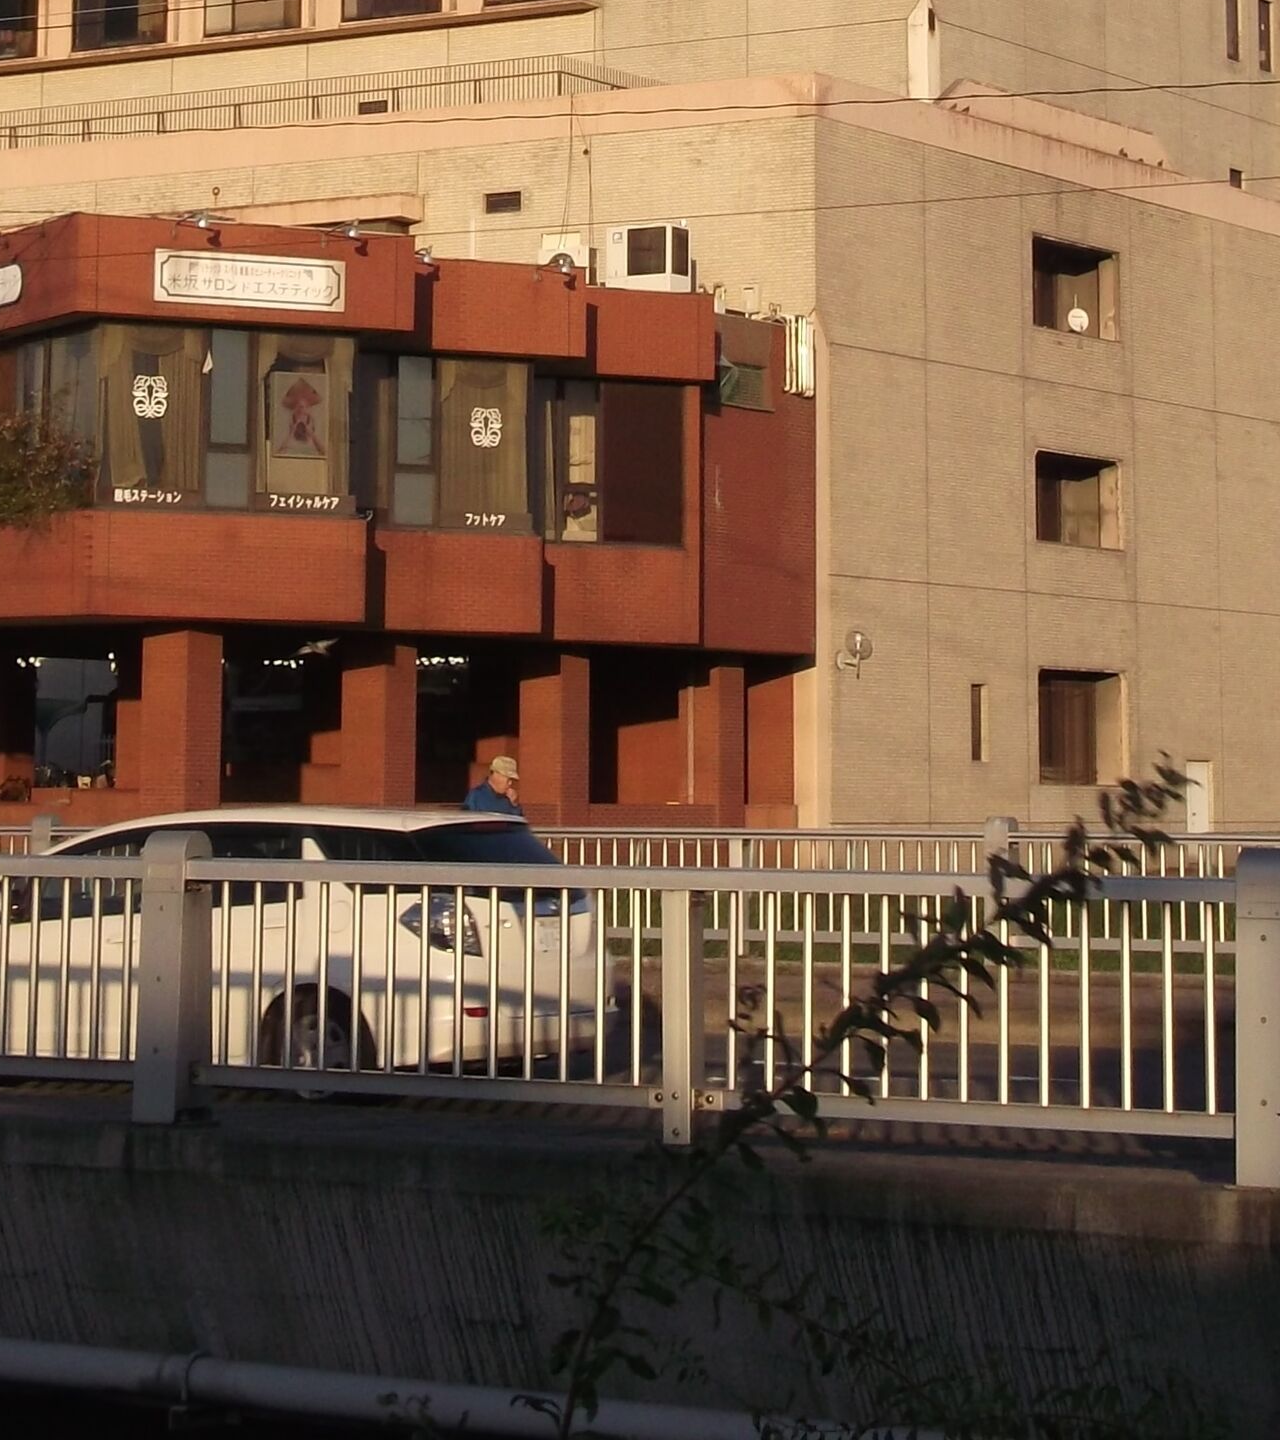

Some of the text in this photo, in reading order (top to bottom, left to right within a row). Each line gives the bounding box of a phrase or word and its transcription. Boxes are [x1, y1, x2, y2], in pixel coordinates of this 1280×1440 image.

[269, 494, 340, 509] フェイシャルケア
[465, 512, 506, 526] フットケア
